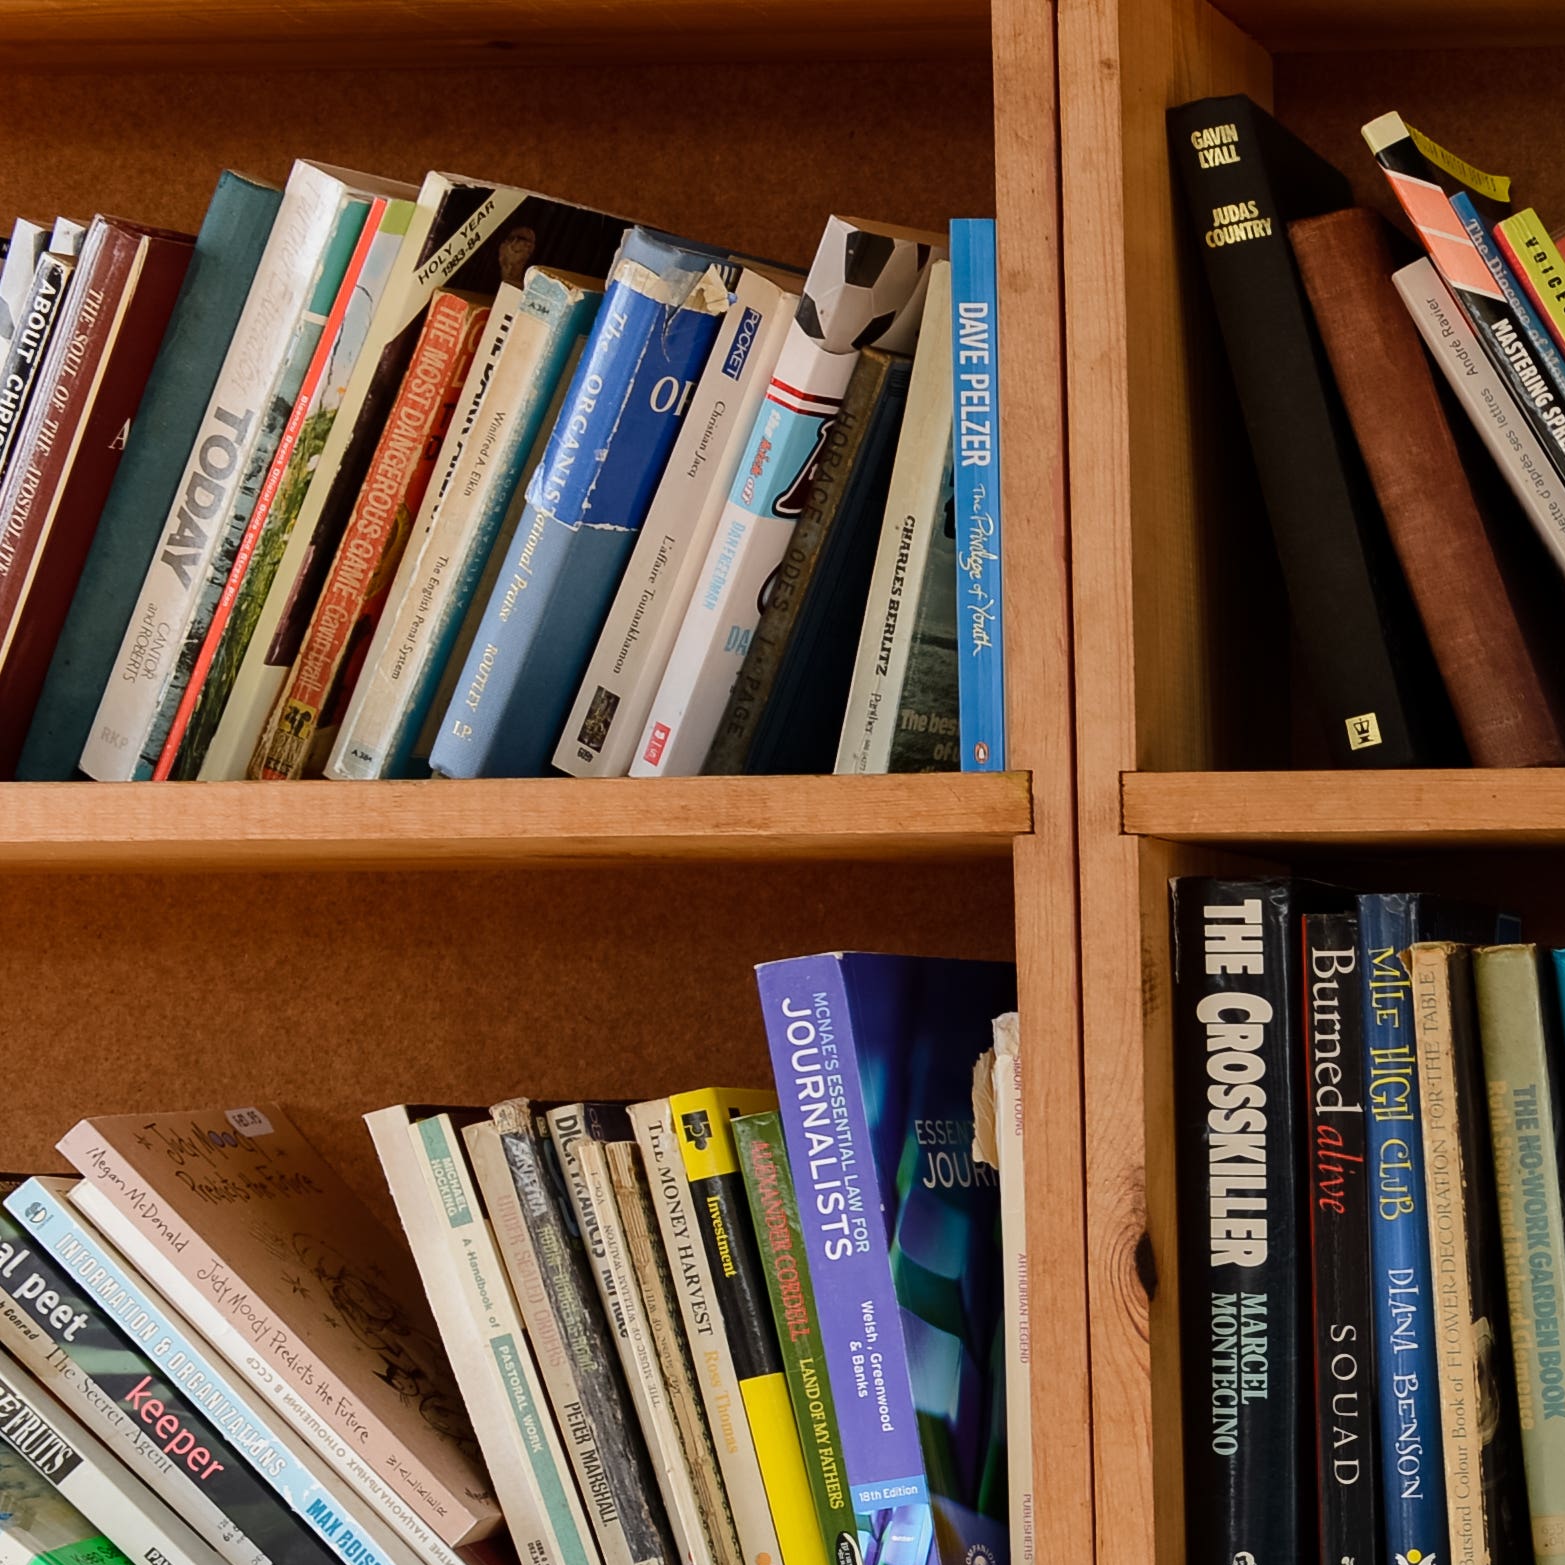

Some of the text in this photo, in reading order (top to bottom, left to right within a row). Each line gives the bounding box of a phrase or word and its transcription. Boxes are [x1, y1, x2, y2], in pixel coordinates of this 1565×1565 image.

[1191, 124, 1239, 150] GAVIN
[1199, 145, 1240, 169] LYALL
[1205, 218, 1272, 248] COUNTRY
[1211, 200, 1259, 225] JUDAS
[959, 302, 992, 467] DAVE PELZER
[1490, 318, 1553, 414] MASTERING
[687, 400, 726, 478] Christian Jacq
[161, 405, 255, 590] TODAY
[875, 514, 916, 677] CHARLES BERLITZ
[780, 996, 853, 1262] JOURNALISTS
[1196, 899, 1274, 1269] THE CROSSKILLER
[1311, 946, 1365, 1216] Burned alive
[498, 1345, 544, 1454] PASTORAL WORK
[1211, 1292, 1239, 1457] MONTECINO
[1241, 1292, 1269, 1405] MARCEL
[125, 1376, 225, 1482] keeper
[1329, 1324, 1360, 1486] SOUAD
[305, 1497, 345, 1537] MAX
